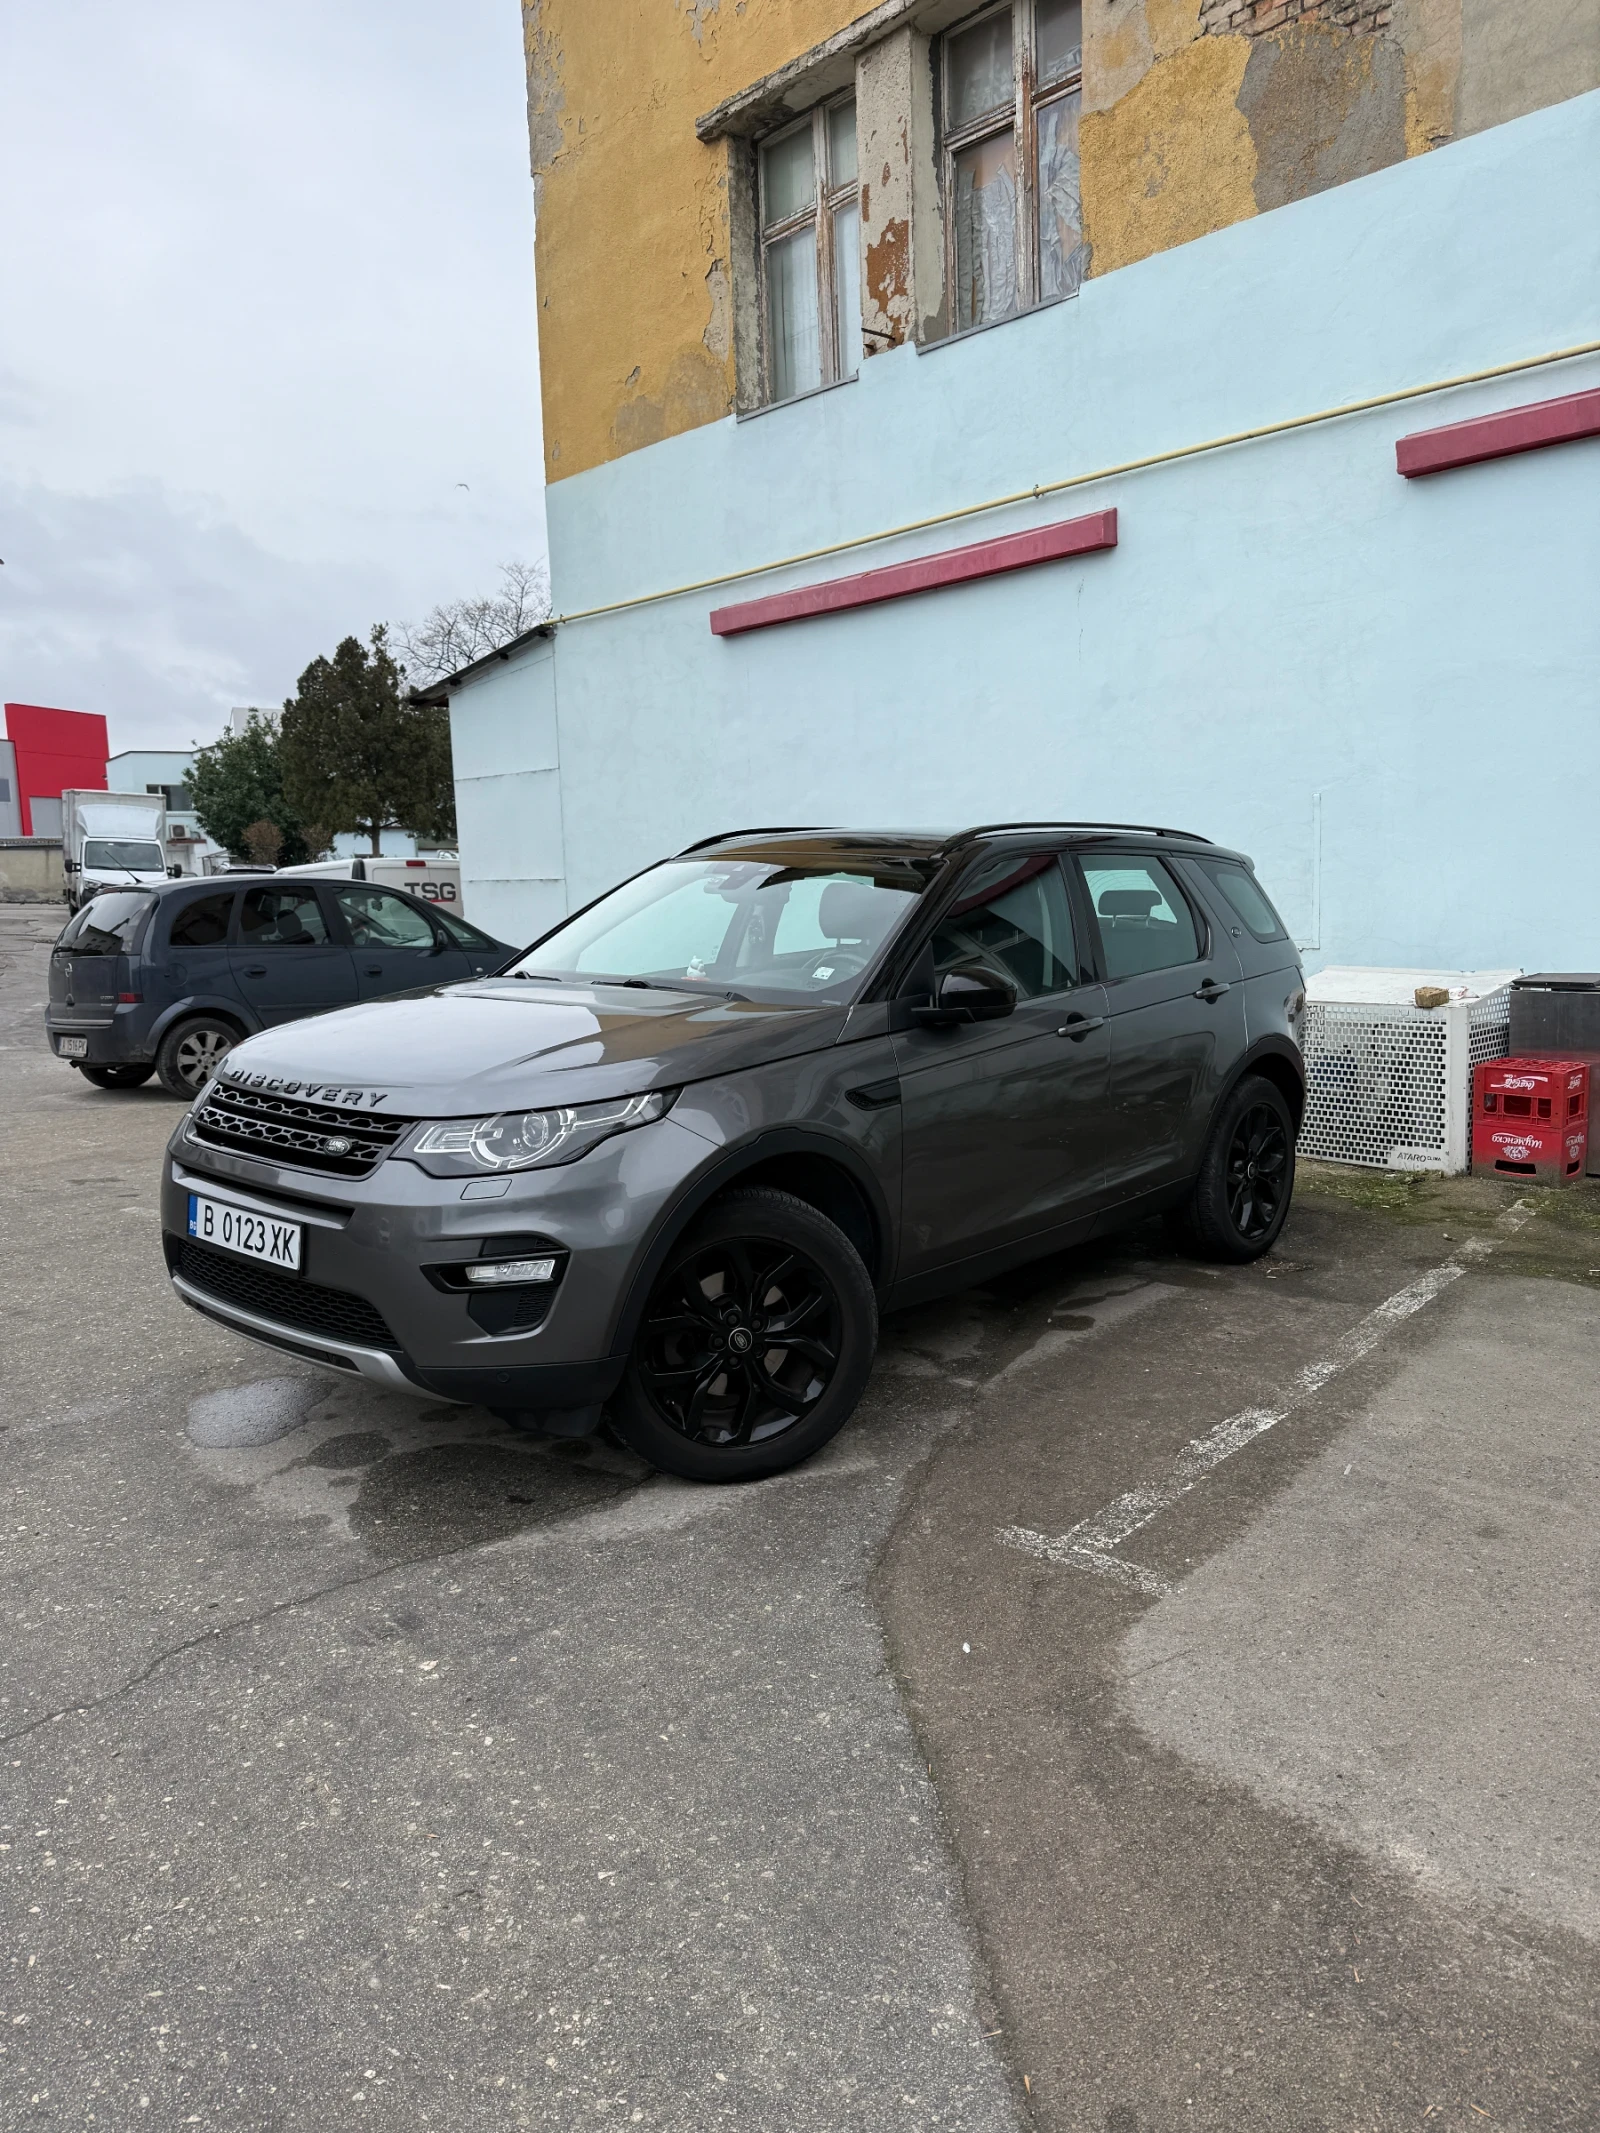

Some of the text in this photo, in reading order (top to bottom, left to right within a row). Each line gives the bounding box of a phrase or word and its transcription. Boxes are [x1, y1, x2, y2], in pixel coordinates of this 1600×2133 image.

[404, 882, 457, 901] TSG
[229, 1068, 388, 1107] DISCOVERY
[1491, 1132, 1543, 1149] Шуменско
[1397, 1152, 1426, 1162] ATARO
[203, 1204, 214, 1237] B
[223, 1211, 265, 1253] 0123
[269, 1223, 295, 1264] XK
